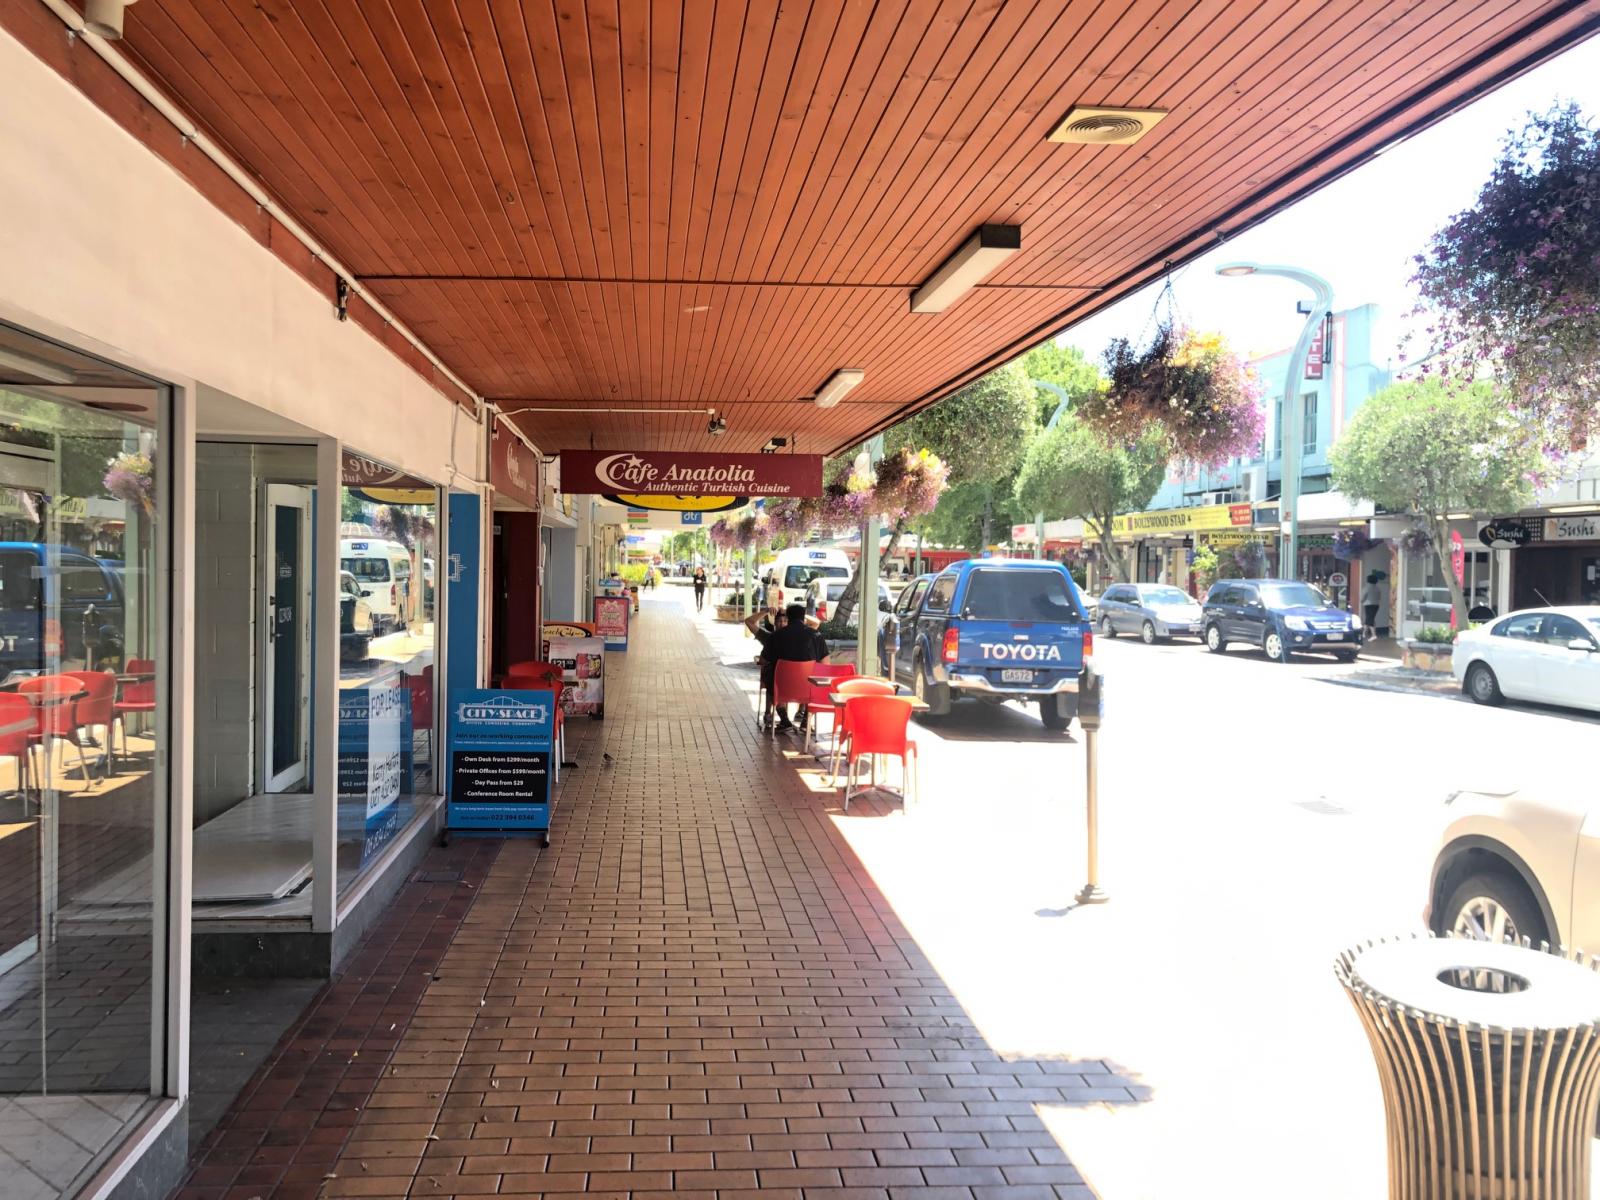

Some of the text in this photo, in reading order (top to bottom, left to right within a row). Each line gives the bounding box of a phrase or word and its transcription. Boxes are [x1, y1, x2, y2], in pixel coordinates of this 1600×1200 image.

[608, 462, 755, 484] Cafe Anatolia
[643, 482, 790, 493] Authentic Turkish Cuisine
[1134, 515, 1169, 529] BOLLYWOOD
[1170, 514, 1186, 527] STAR
[1558, 519, 1595, 537] Sushi
[1496, 528, 1524, 541] Sushi
[980, 643, 1061, 661] TOYOTA
[466, 708, 538, 719] CITY SPACE
